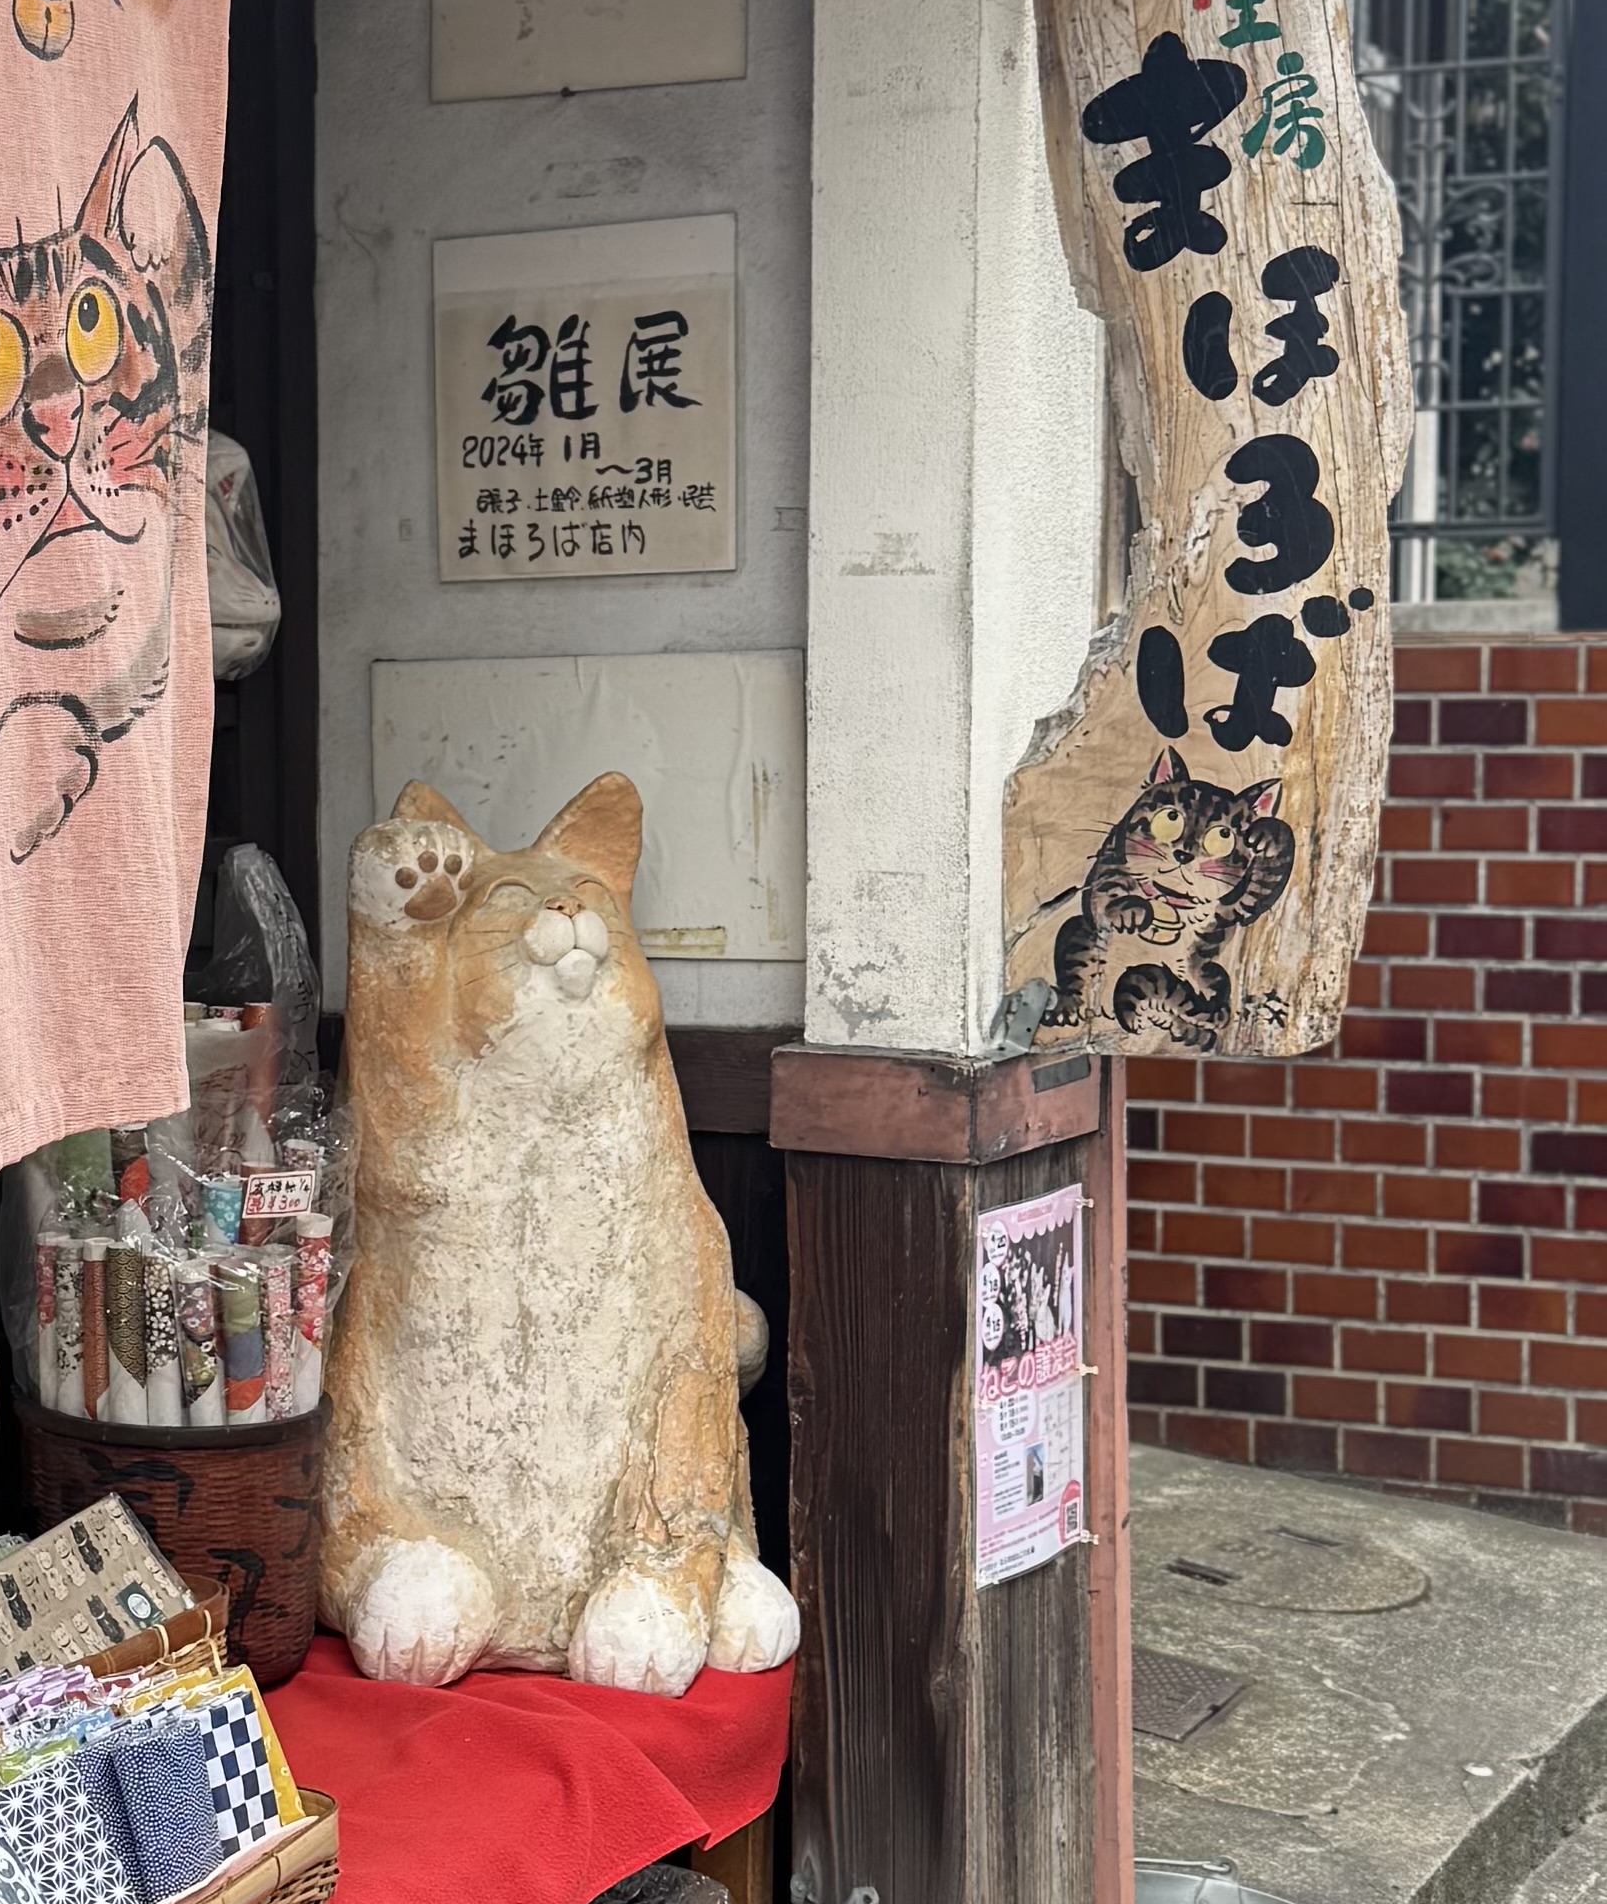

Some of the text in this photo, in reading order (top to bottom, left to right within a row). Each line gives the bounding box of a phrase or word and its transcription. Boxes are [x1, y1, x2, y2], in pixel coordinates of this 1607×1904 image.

[458, 519, 646, 562] まほろば店内
[1081, 31, 1373, 751] まほろば
